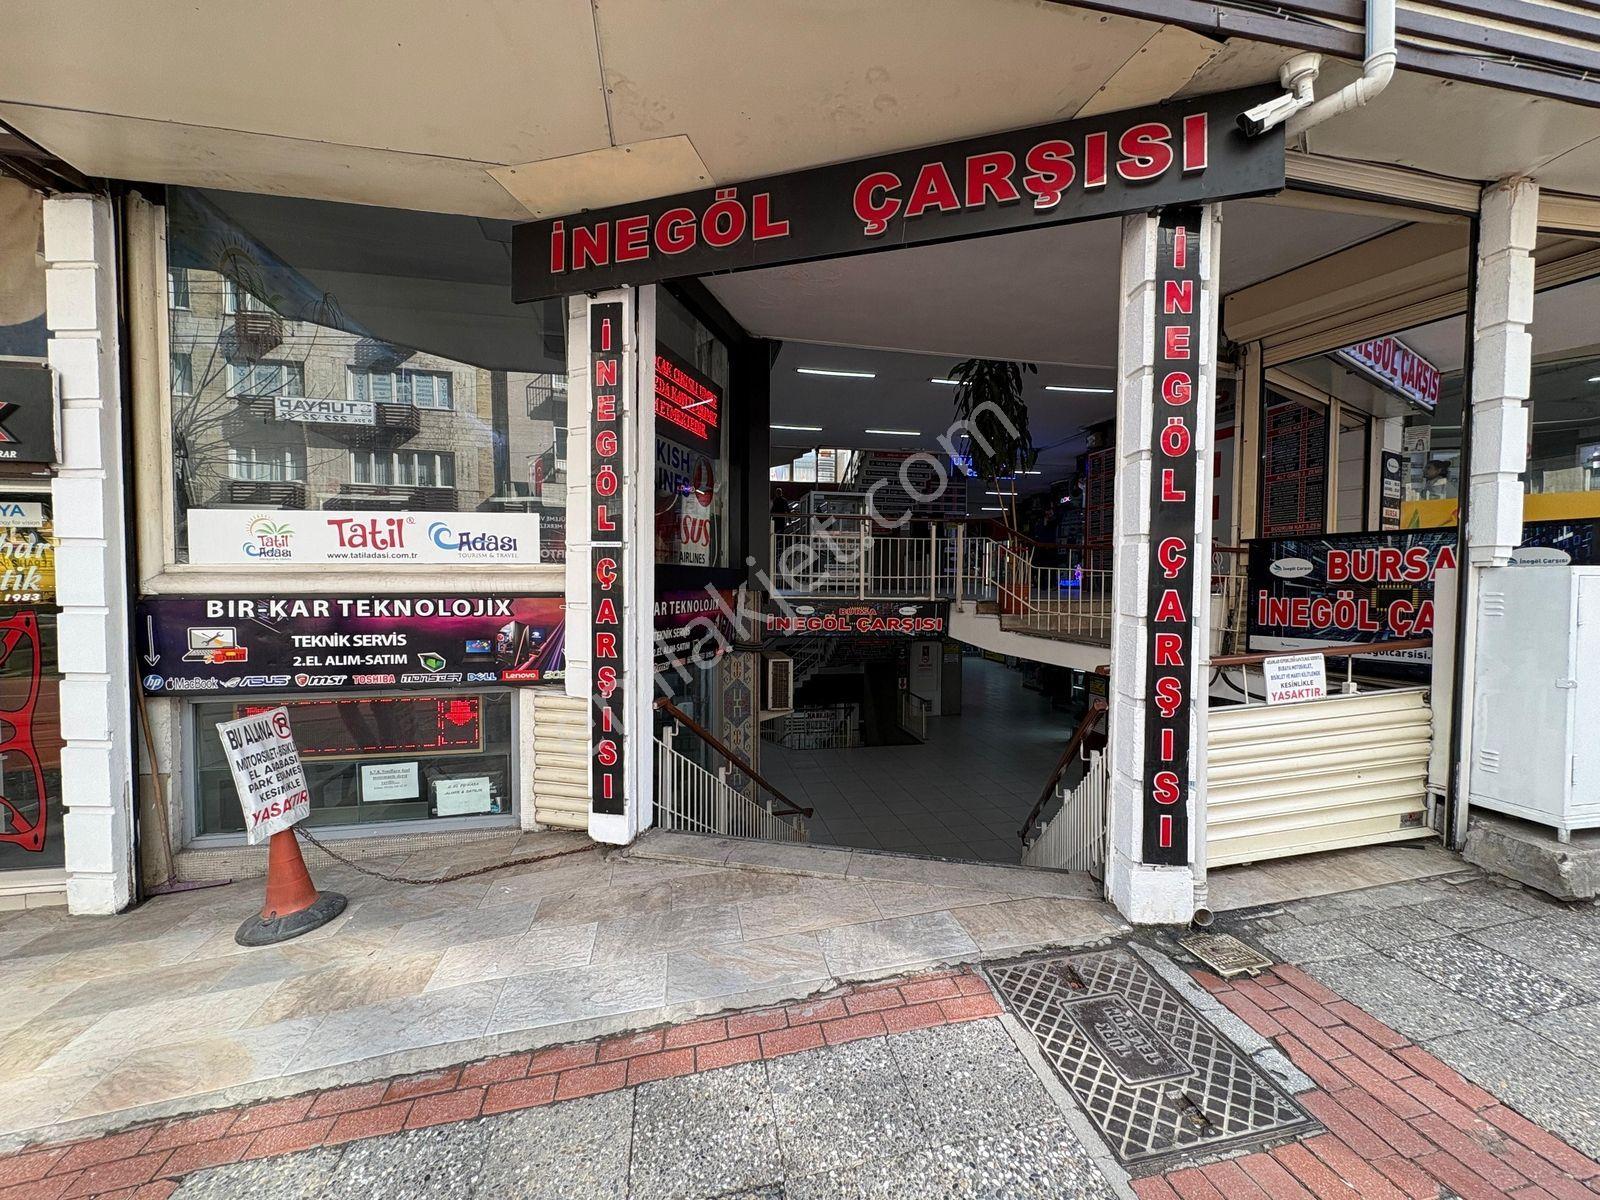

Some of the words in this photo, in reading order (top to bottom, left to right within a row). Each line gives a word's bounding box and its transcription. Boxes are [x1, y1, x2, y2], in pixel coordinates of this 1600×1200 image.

[550, 187, 790, 275] İNEGÖL
[853, 111, 1209, 237] ÇARŞISI
[1160, 225, 1193, 502] İNEGÖL
[595, 318, 618, 532] İNEGÖL
[257, 535, 289, 549] Tatil
[327, 517, 404, 551] Tatil
[458, 531, 518, 551] Adası
[258, 547, 292, 558] Adası
[327, 551, 418, 560] www.tatiladasi.com.tr
[679, 550, 706, 564] AIRLINES
[1326, 545, 1457, 582] BURSA
[4, 593, 41, 602] 1983
[337, 597, 512, 617] TEKNOLOJİX
[838, 607, 878, 616] BURSA
[1258, 590, 1379, 631] İNEGÖL
[766, 613, 851, 631] İNEGÖL
[856, 617, 943, 634] ÇARŞISI
[291, 632, 350, 649] TEKNİK
[353, 631, 407, 647] SERVİS
[293, 656, 323, 667] 2.EL
[325, 654, 408, 666] ALIM-SATIM
[146, 676, 162, 690] hp
[175, 677, 219, 690] MacBook
[239, 675, 292, 687] ASUS
[352, 674, 396, 684] TOSHIBA
[467, 672, 497, 682] DELL
[505, 671, 536, 680] Lenovo
[595, 557, 619, 800] ÇARŞISI
[1280, 679, 1314, 689] KESİNLİKLE
[1152, 536, 1187, 848] ÇARŞISI
[1271, 687, 1324, 702] YASAKTIR.
[226, 727, 243, 750] BU
[243, 720, 275, 746] ALANA
[248, 769, 261, 781] EL
[248, 776, 274, 794] PARK
